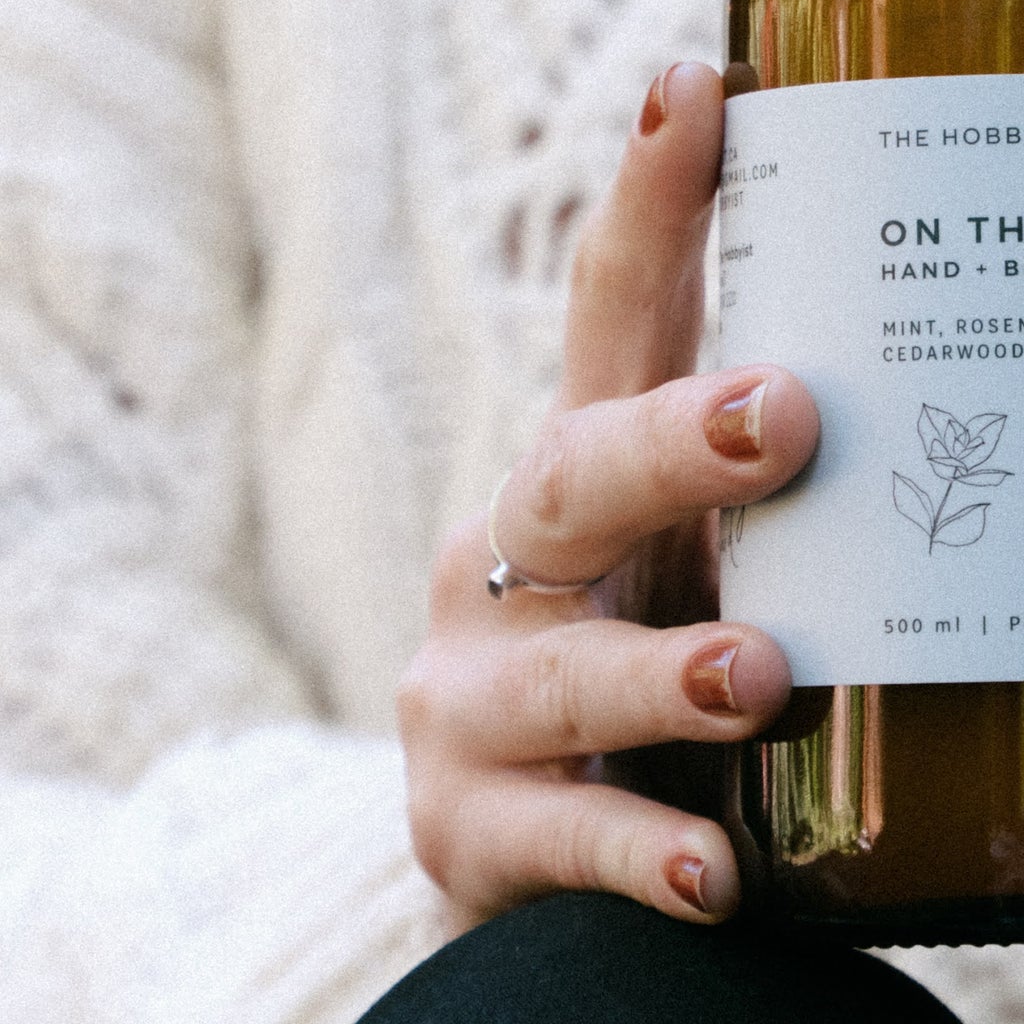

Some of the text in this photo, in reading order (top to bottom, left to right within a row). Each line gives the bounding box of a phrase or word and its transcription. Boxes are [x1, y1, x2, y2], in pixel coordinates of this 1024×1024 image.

[878, 128, 929, 149] THE
[879, 217, 942, 248] ON
[880, 260, 961, 281] HAND
[975, 263, 989, 275] +
[882, 319, 943, 339] MINT,
[884, 617, 923, 635] 500
[934, 616, 961, 633] ml
